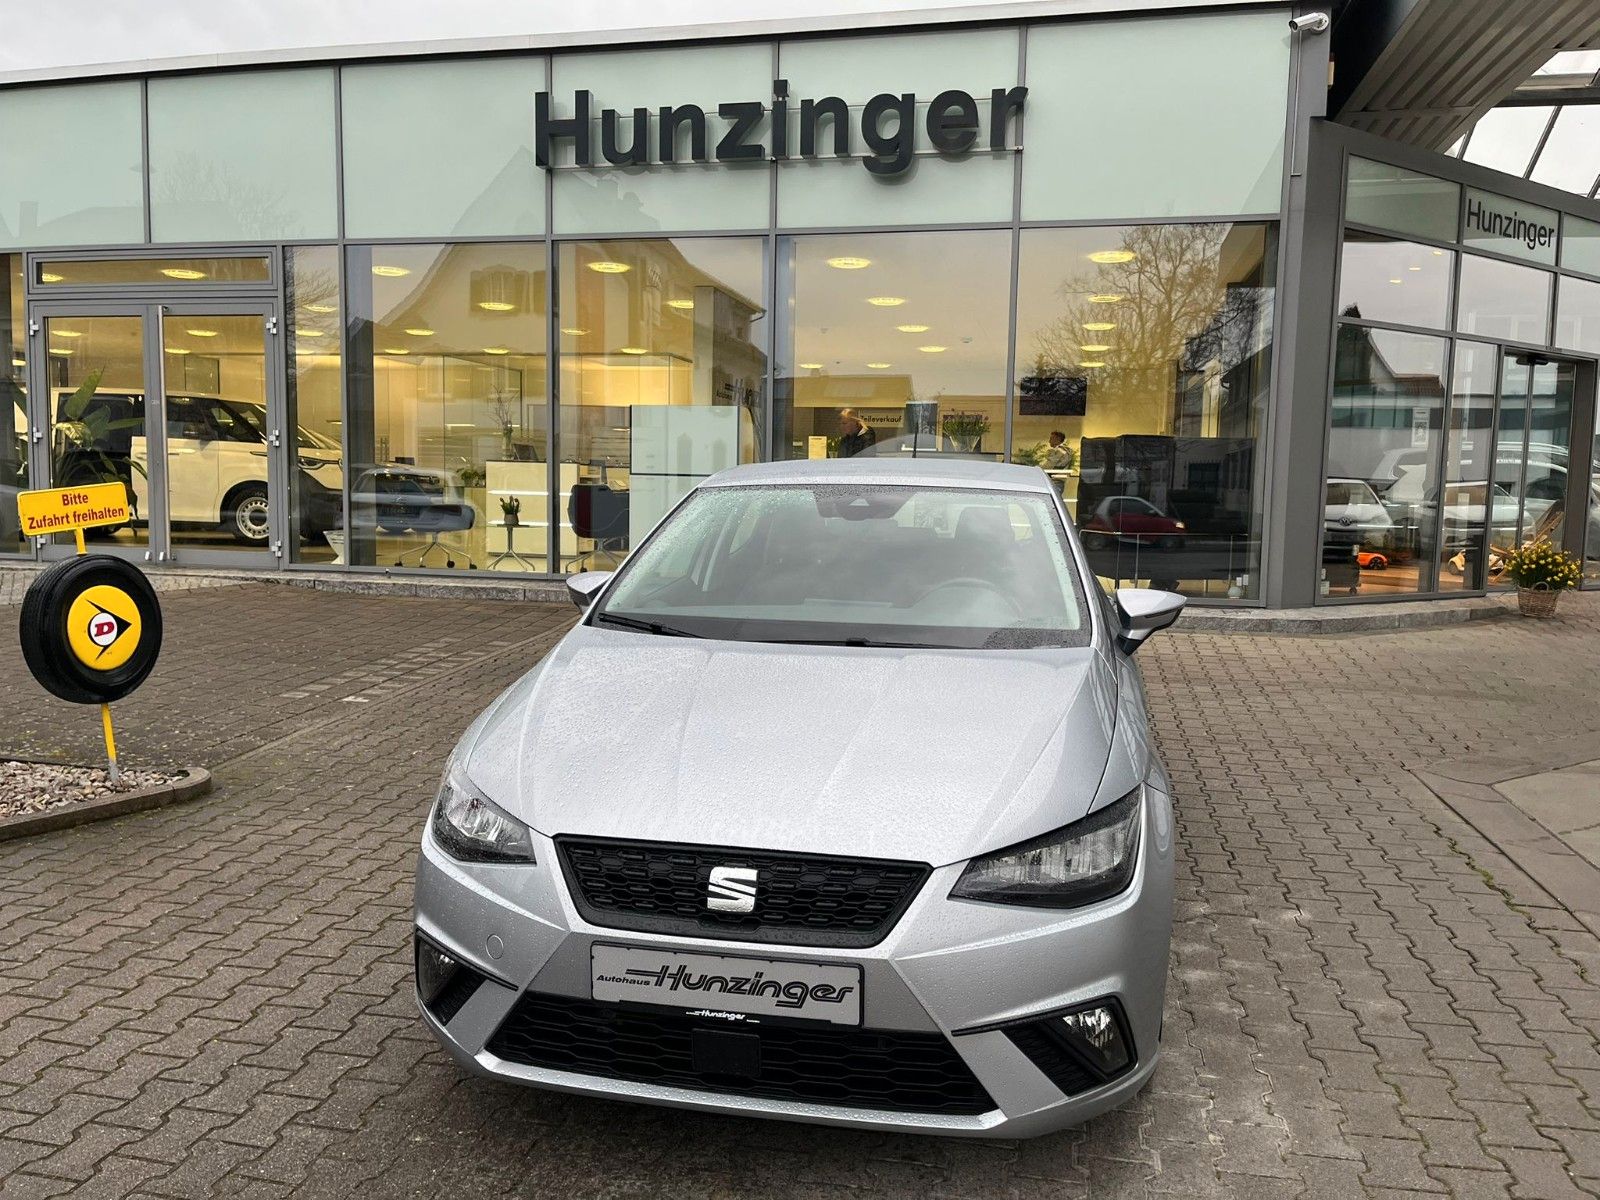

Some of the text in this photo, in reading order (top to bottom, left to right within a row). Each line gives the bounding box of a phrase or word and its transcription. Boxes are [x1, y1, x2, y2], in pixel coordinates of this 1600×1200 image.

[535, 79, 1028, 175] Hunzinger
[1467, 199, 1554, 250] Hunzinger
[62, 493, 89, 506] Bitte
[28, 507, 124, 530] Zufahrt freihalten
[95, 621, 115, 637] D
[597, 964, 854, 1009] Autohaus Hunzinger
[697, 1010, 746, 1020] Hunzinger
